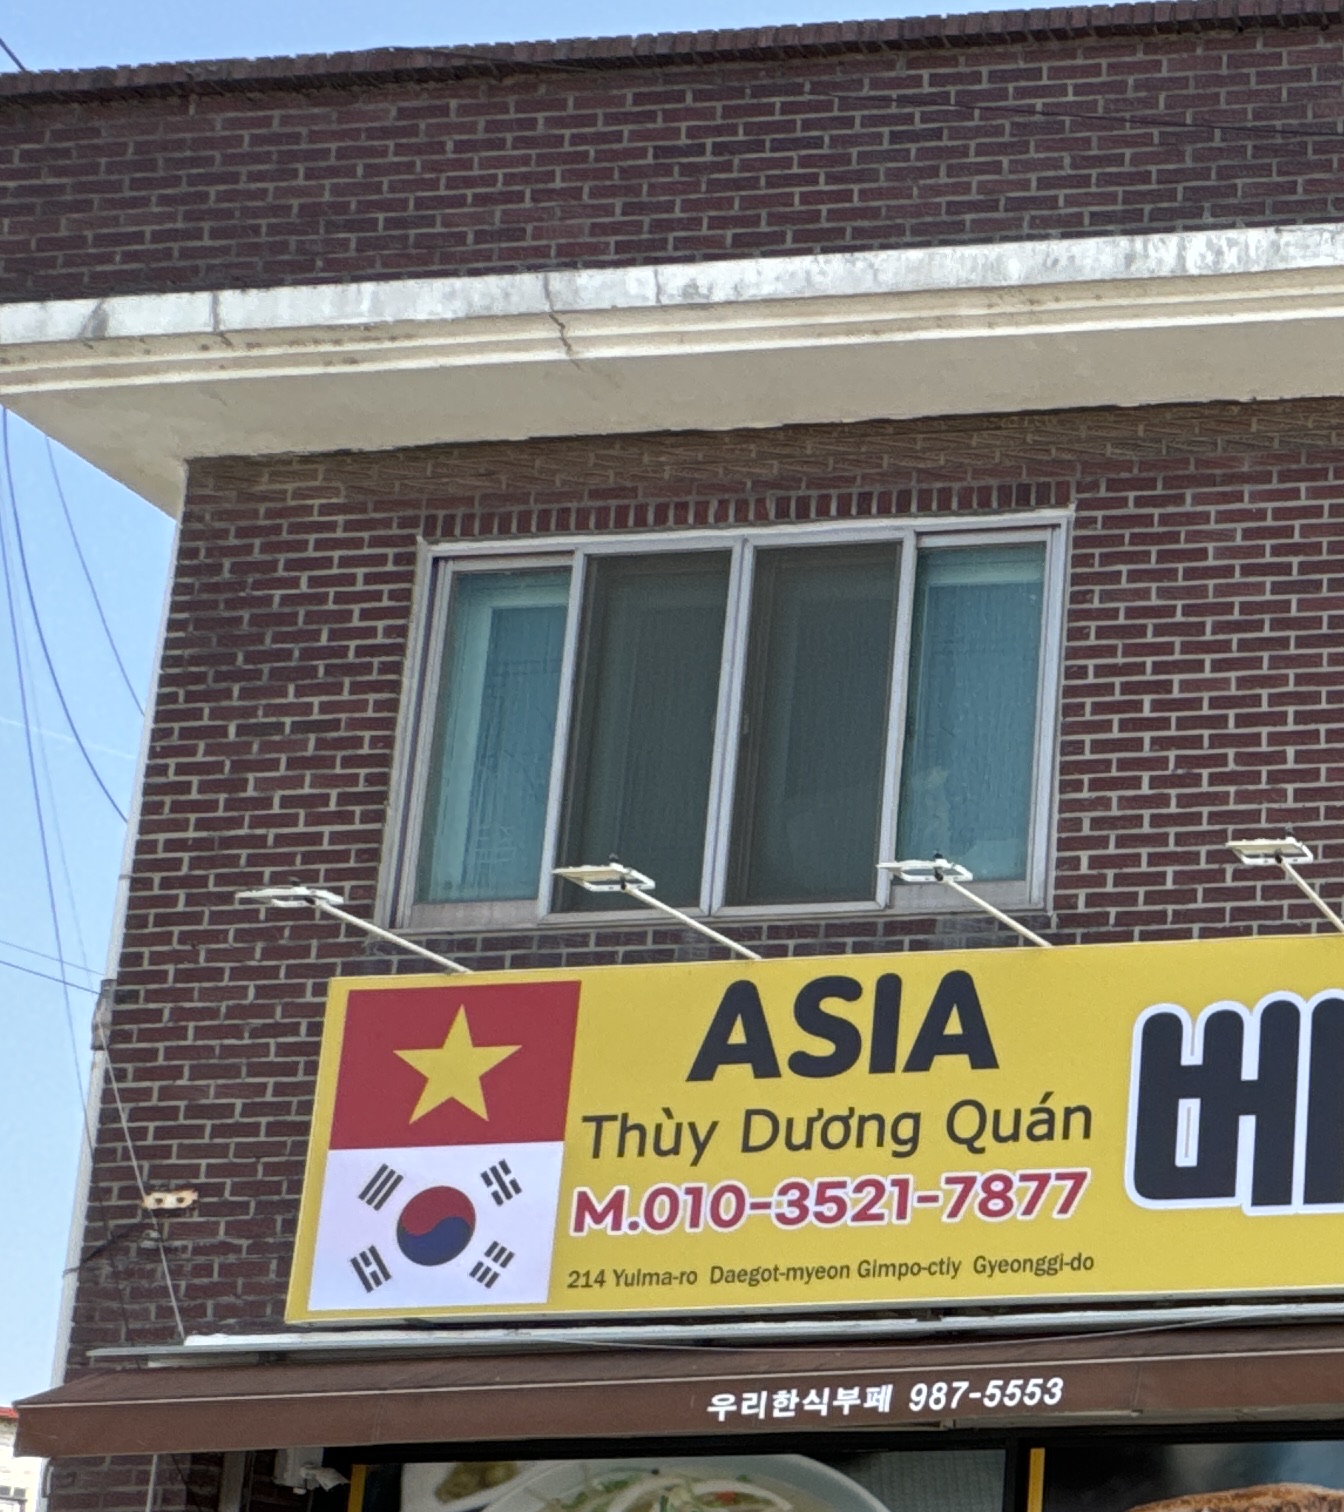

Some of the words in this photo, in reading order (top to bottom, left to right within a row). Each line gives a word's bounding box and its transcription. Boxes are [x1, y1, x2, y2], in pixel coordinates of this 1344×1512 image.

[686, 969, 999, 1081] ASIA
[582, 1106, 718, 1166] Thùy
[740, 1106, 920, 1157] Dương
[946, 1091, 1092, 1153] Quán
[571, 1169, 1091, 1237] M.010-3521-7877
[567, 1270, 606, 1289] 214
[612, 1268, 698, 1288] Yulma-ro
[709, 1262, 850, 1286] Daegot-myeon
[973, 1252, 1094, 1278] Gyeonggi-do
[708, 1386, 892, 1421] 우리한식부페
[909, 1378, 1063, 1411] 987-5553
